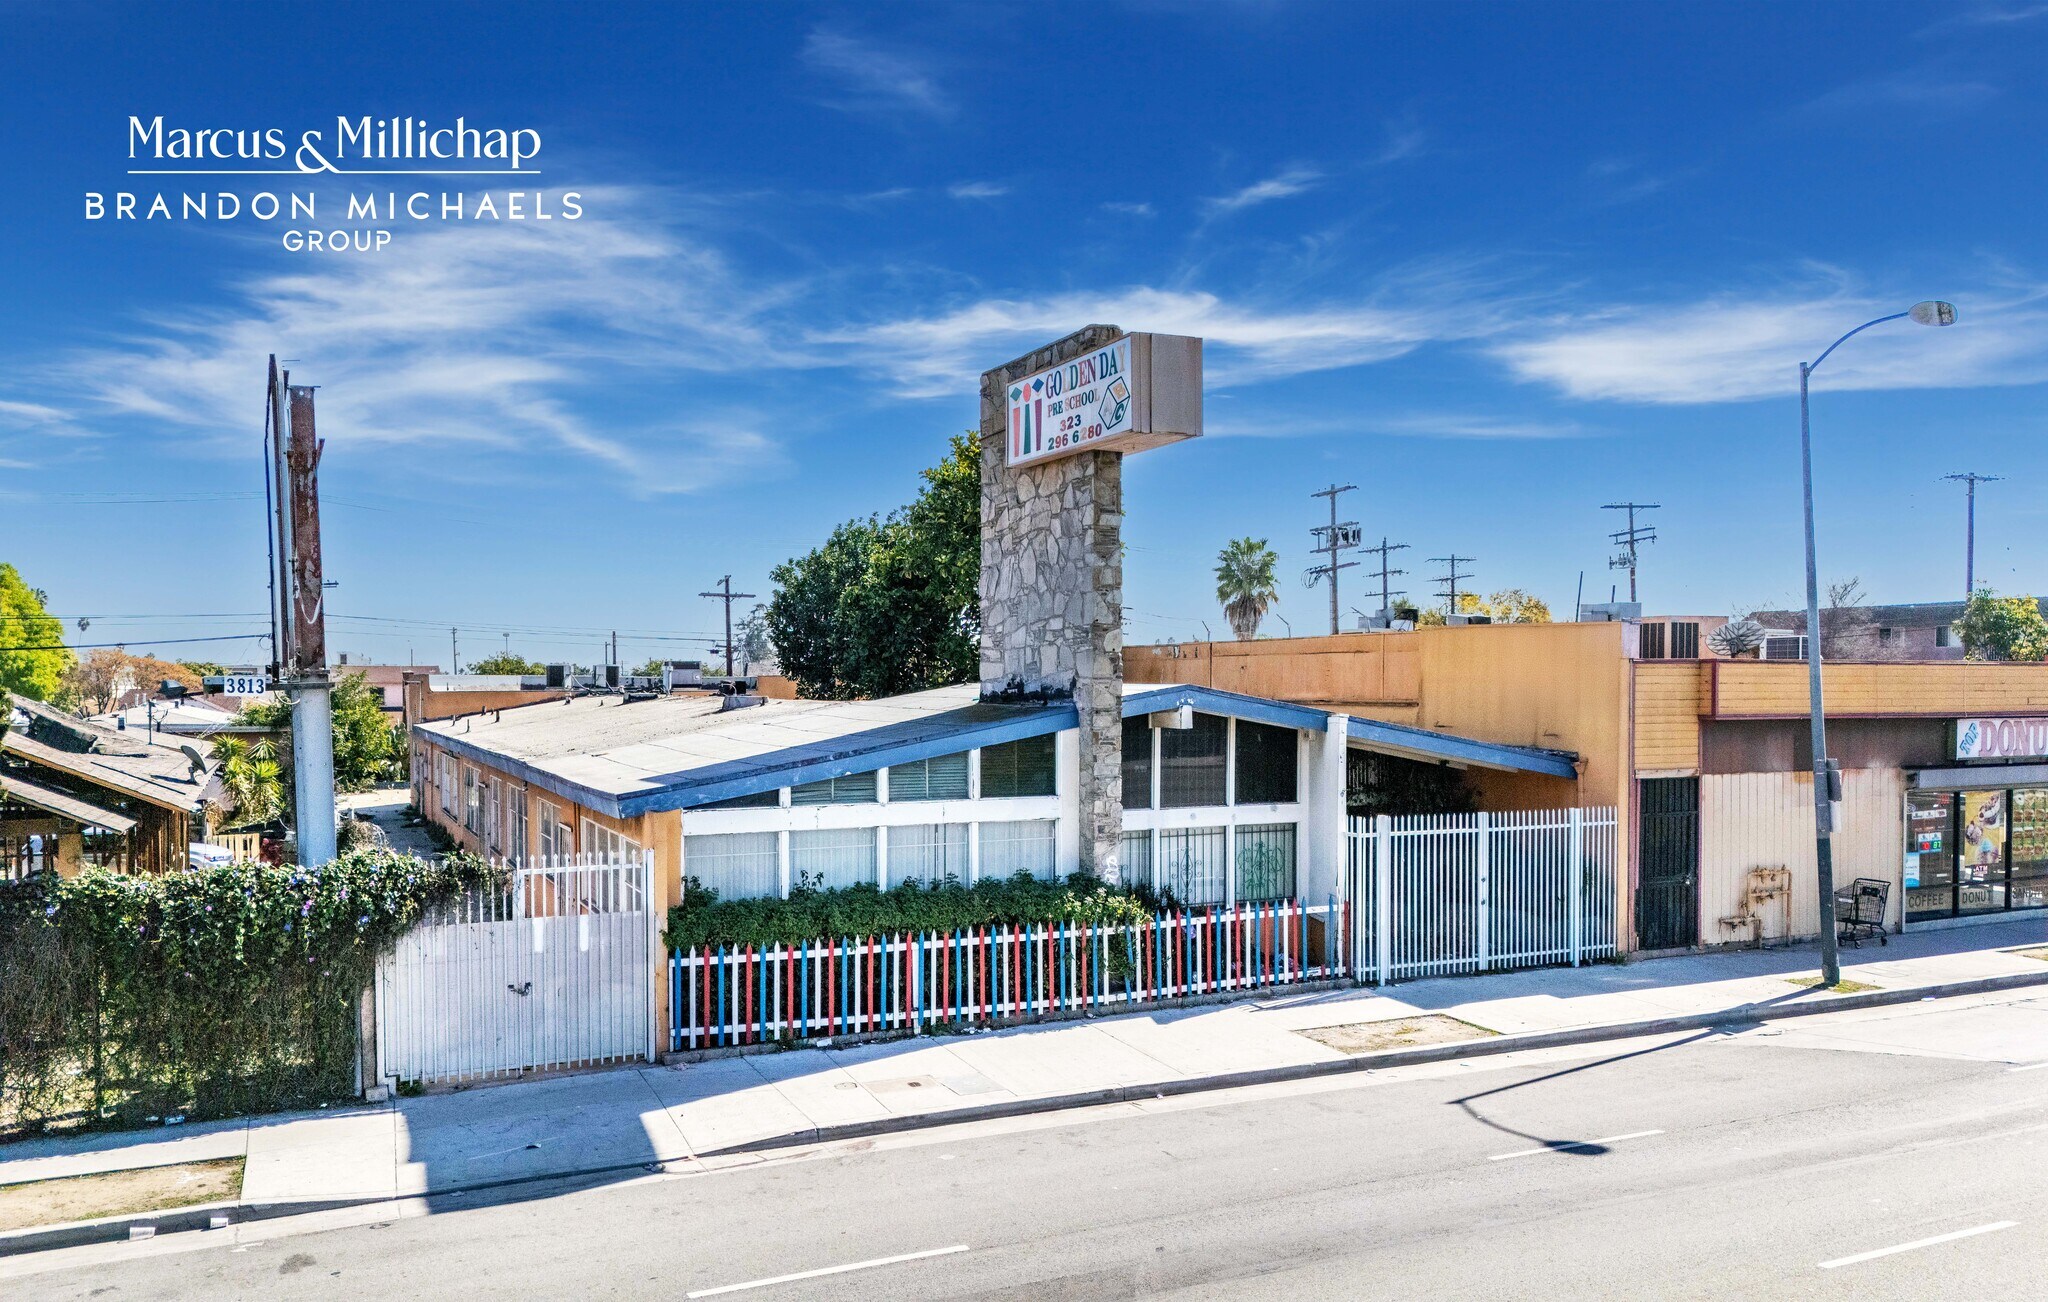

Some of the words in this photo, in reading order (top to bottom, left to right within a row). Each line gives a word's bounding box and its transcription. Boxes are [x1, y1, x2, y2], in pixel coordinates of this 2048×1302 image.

[1045, 356, 1098, 400] GOLDEN
[1099, 343, 1126, 380] DAY
[1047, 400, 1063, 418] PRE
[1064, 388, 1100, 412] SCHOOL
[1048, 432, 1069, 451] 296
[1072, 423, 1102, 443] 6280
[1060, 414, 1082, 432] 323
[227, 678, 264, 694] 3813
[1960, 722, 1979, 755] TOP
[1908, 893, 1944, 908] COFFEE
